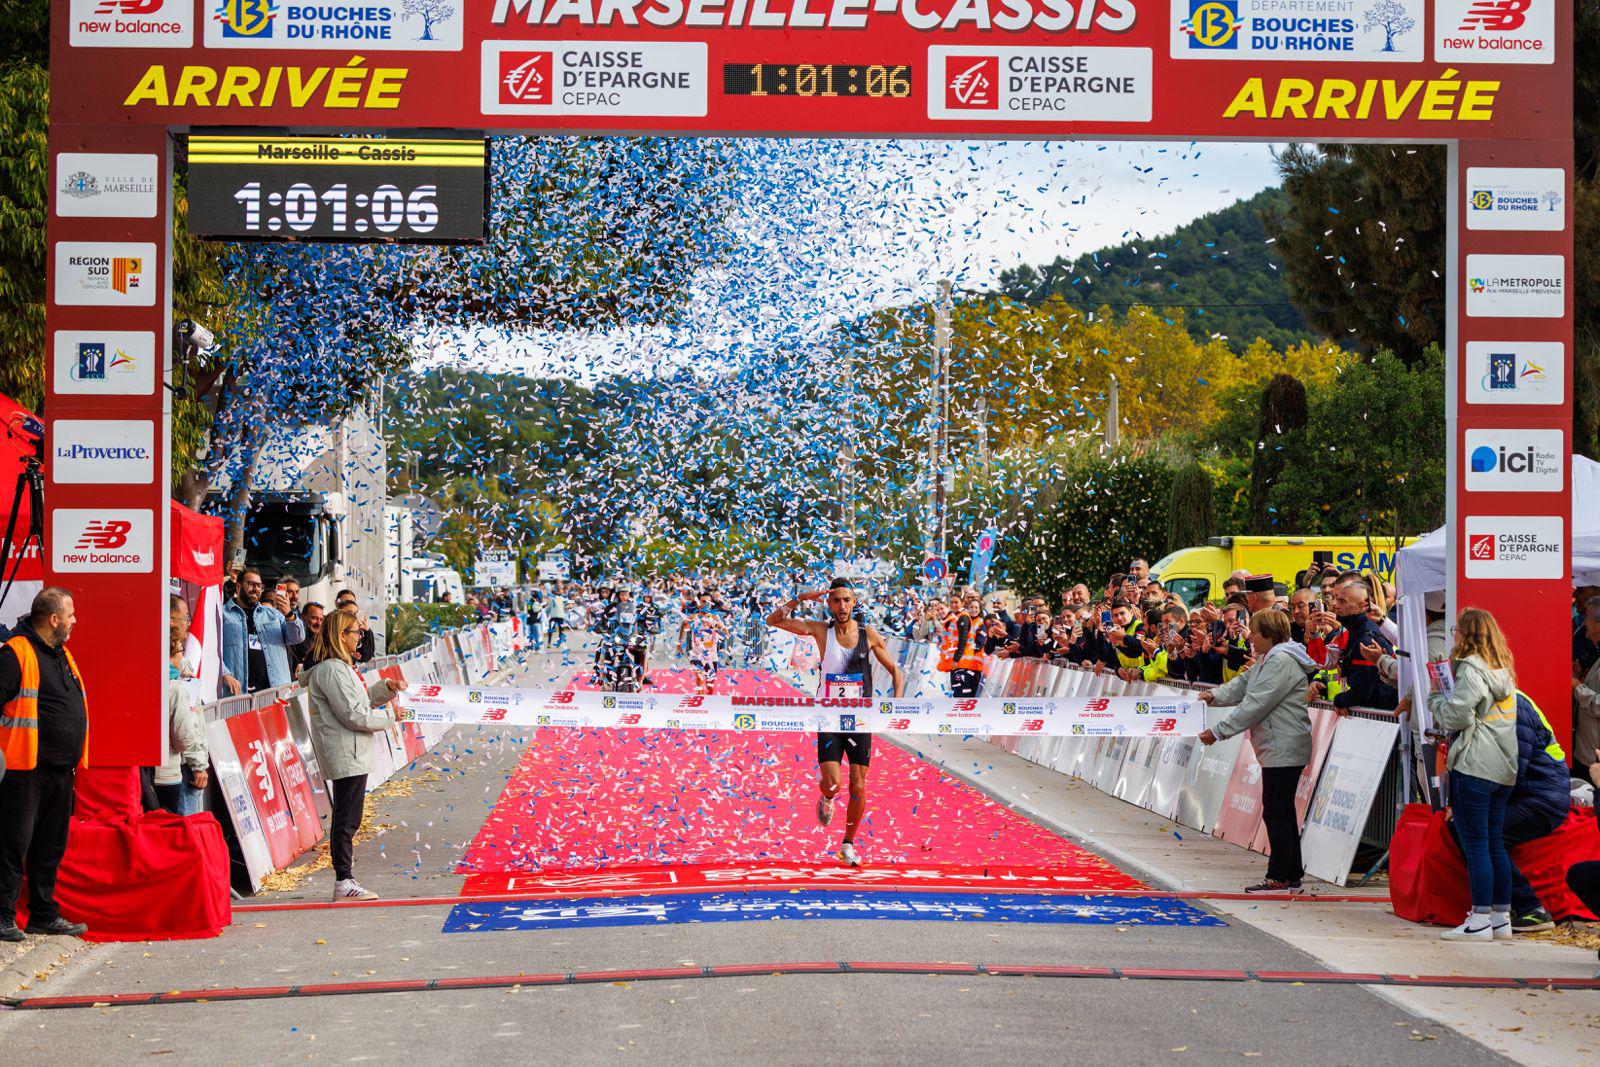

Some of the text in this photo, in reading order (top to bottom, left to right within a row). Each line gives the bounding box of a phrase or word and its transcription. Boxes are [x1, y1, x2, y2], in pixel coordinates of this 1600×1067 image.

[287, 6, 392, 21] BOUCHES
[79, 20, 182, 34] new balance
[287, 22, 392, 40] DU RHÔNE
[1252, 18, 1354, 33] BOUCHES
[1251, 33, 1354, 51] DU RHÔNE
[1443, 36, 1543, 50] new balance
[562, 51, 643, 69] CAISSE
[1008, 56, 1088, 74] CAISSE
[123, 55, 408, 110] ARRIVÉE
[563, 71, 690, 89] D'EPARGNE
[1009, 76, 1135, 94] D'EPARGNE
[562, 92, 621, 106] CEPAC
[1222, 68, 1501, 121] ARRIVÉE
[1008, 97, 1066, 111] CEPAC
[258, 144, 340, 160] Marseille
[358, 145, 416, 162] Cassis
[104, 184, 155, 194] MARSEILLE
[234, 182, 439, 233] 1:01:06
[88, 267, 110, 275] SUD
[1499, 446, 1534, 473] ici
[1536, 452, 1555, 460] Radio
[1536, 467, 1559, 475] Digital
[1499, 534, 1538, 543] CAISSE
[1499, 544, 1560, 553] D'EPARGNE
[63, 552, 140, 564] new balance
[1336, 552, 1397, 573] SAM
[838, 687, 845, 698] 2
[731, 697, 873, 708] MARSEILLE-CASSIS
